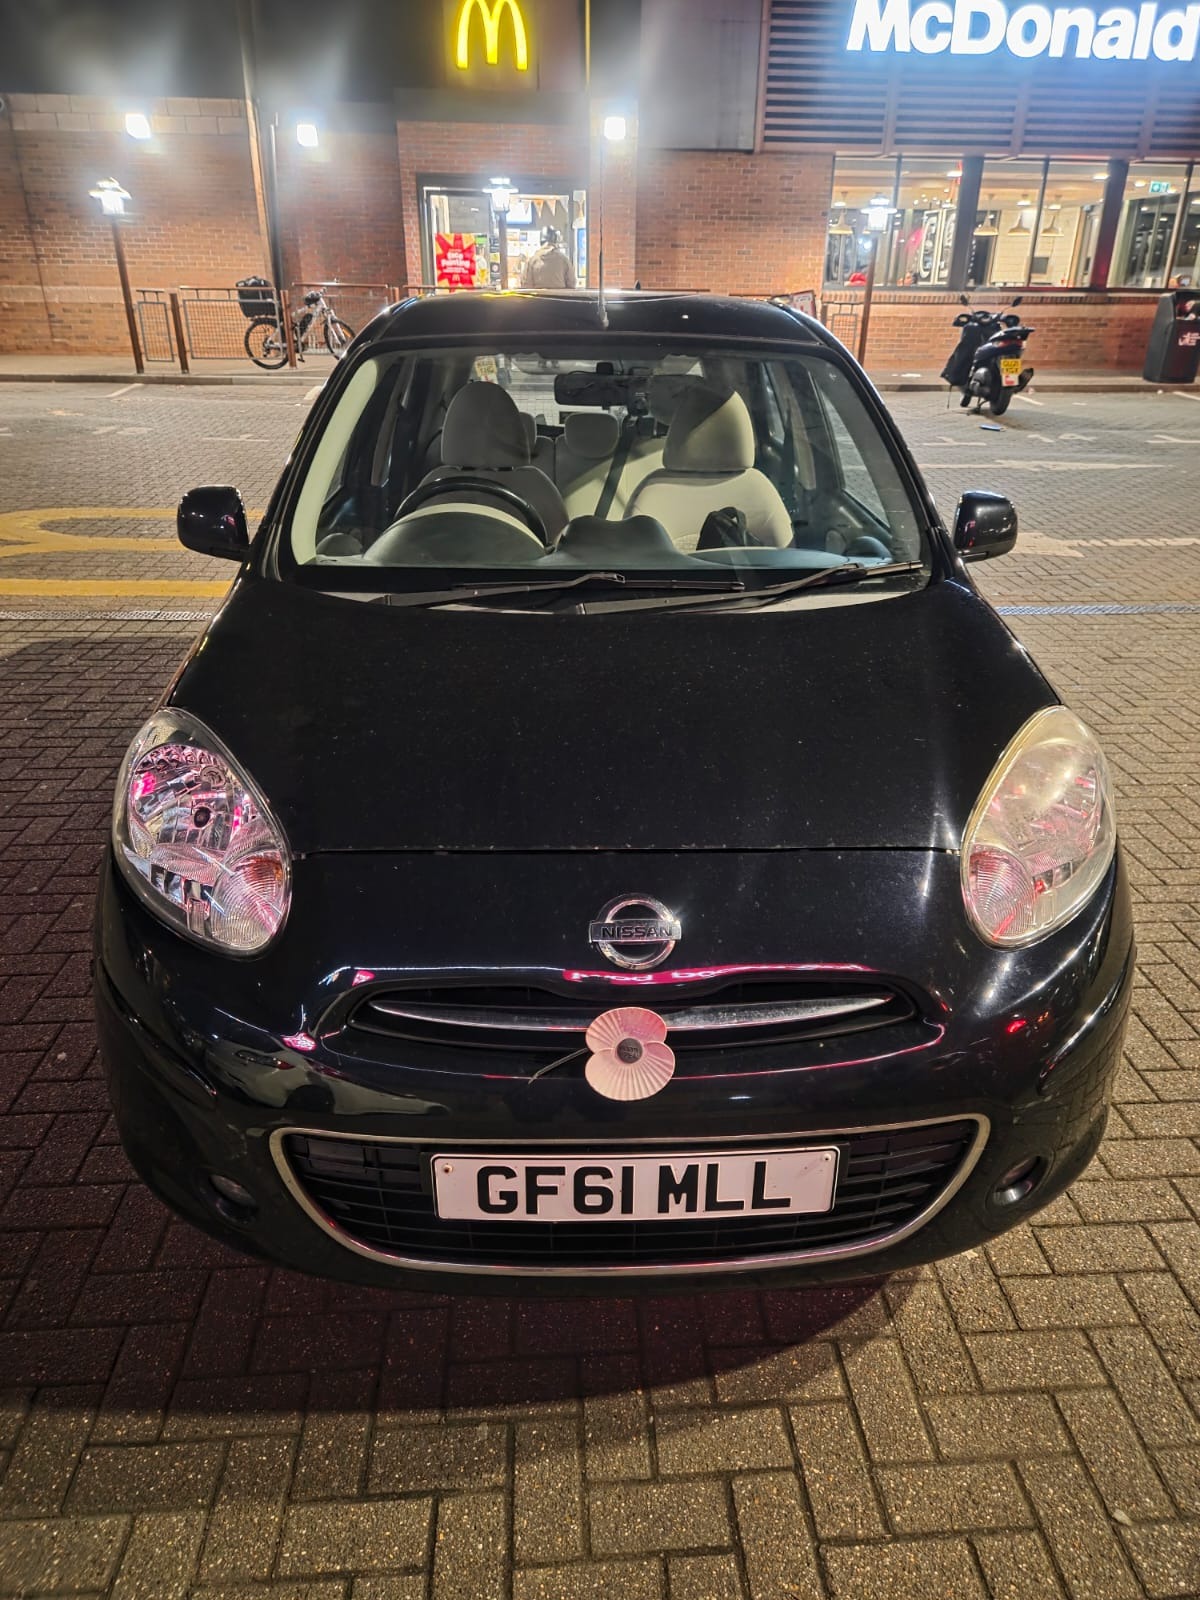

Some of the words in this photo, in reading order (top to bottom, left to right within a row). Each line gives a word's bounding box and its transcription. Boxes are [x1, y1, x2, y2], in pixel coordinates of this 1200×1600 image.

[602, 925, 673, 938] NISSAN
[476, 1164, 634, 1215] GF61
[656, 1160, 791, 1214] MLL
